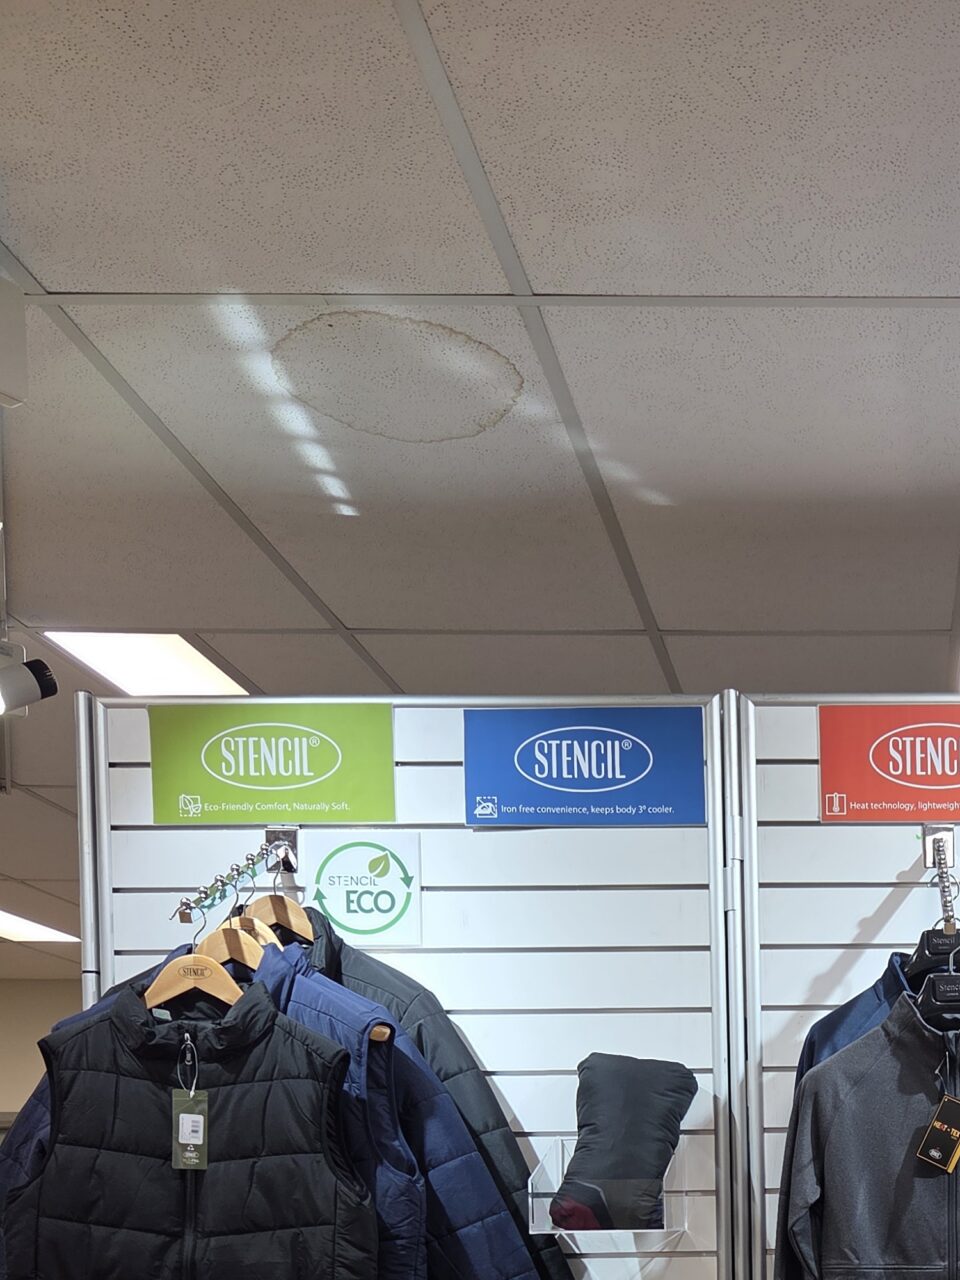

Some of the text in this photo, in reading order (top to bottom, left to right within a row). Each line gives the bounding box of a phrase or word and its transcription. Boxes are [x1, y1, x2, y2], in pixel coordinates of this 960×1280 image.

[204, 801, 351, 812] Eco-Friendly Comfort, Naturally Soft.
[501, 804, 517, 813] Iron
[519, 804, 535, 813] free
[536, 804, 589, 815] convenience,
[590, 804, 615, 815] keeps
[615, 804, 637, 815] body
[647, 804, 676, 814] cooler.
[849, 801, 869, 810] Heat
[870, 801, 917, 812] technology,
[328, 875, 379, 887] STENCIL
[345, 890, 396, 914] ECO
